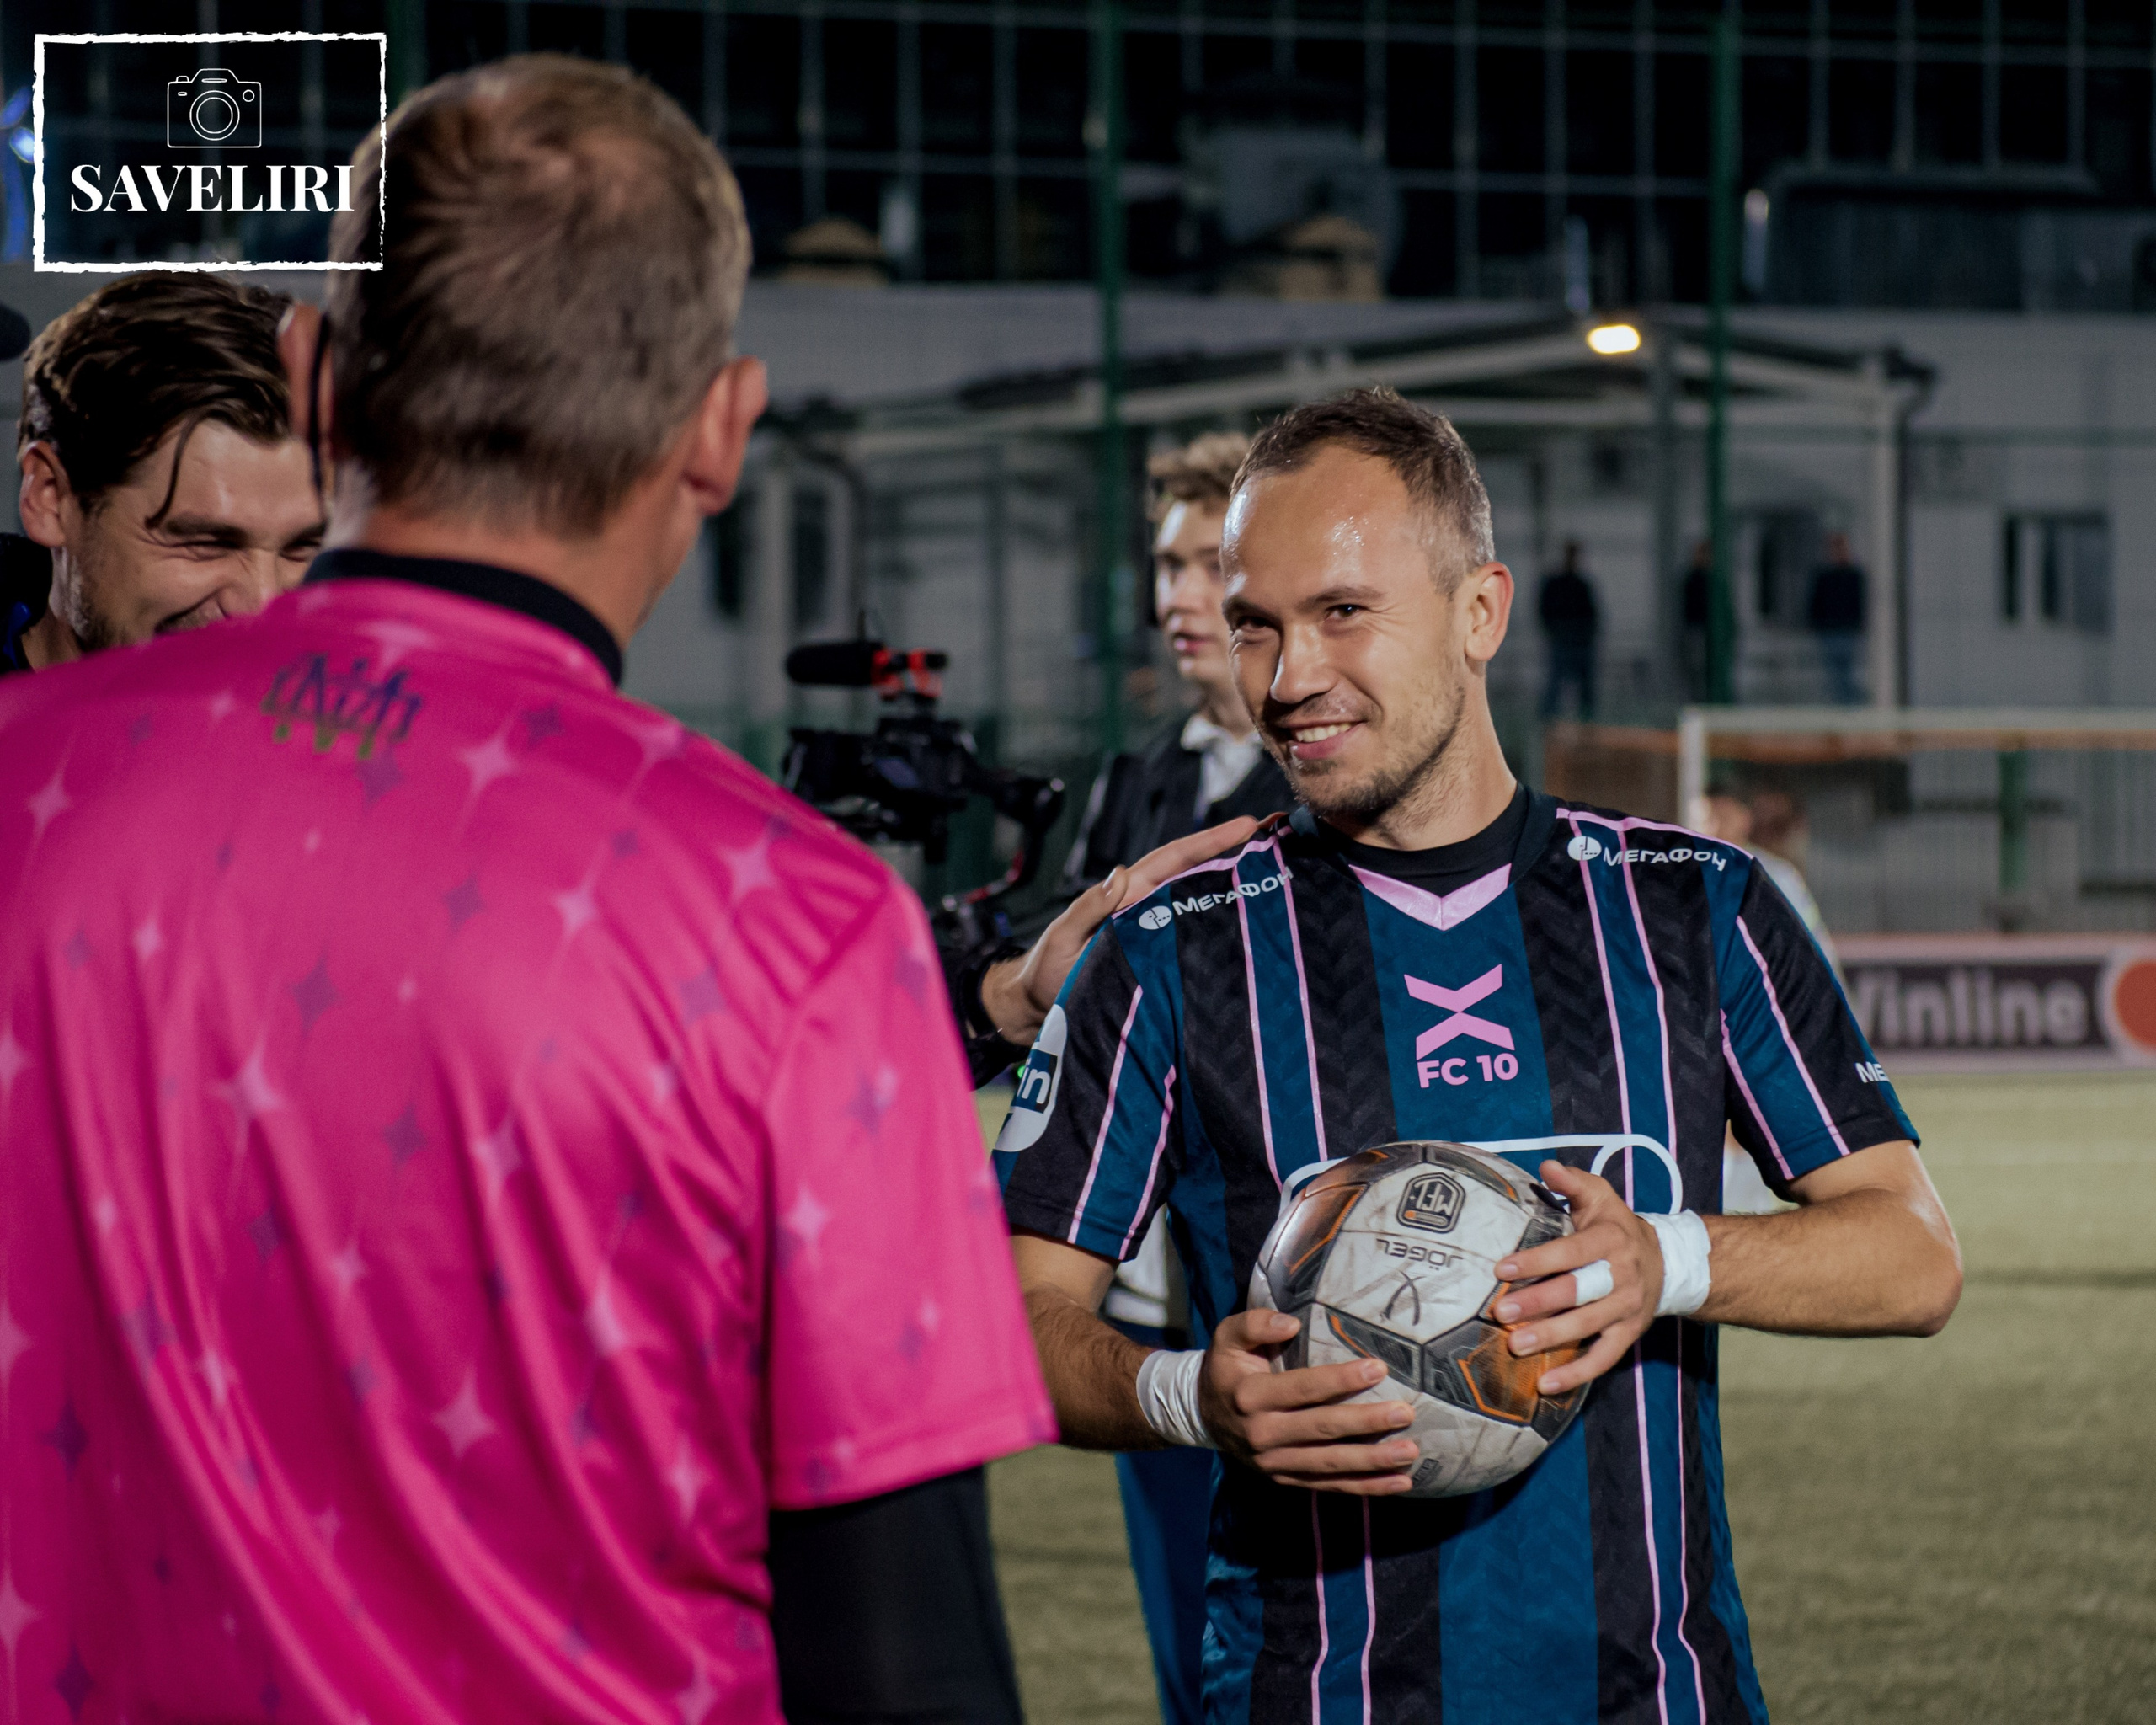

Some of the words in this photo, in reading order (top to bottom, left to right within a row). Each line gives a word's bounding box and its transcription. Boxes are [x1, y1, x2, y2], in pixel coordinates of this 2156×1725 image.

[1417, 1057, 1470, 1089] FC
[1476, 1052, 1519, 1082] 10
[1375, 1238, 1465, 1271] JÖGEL
